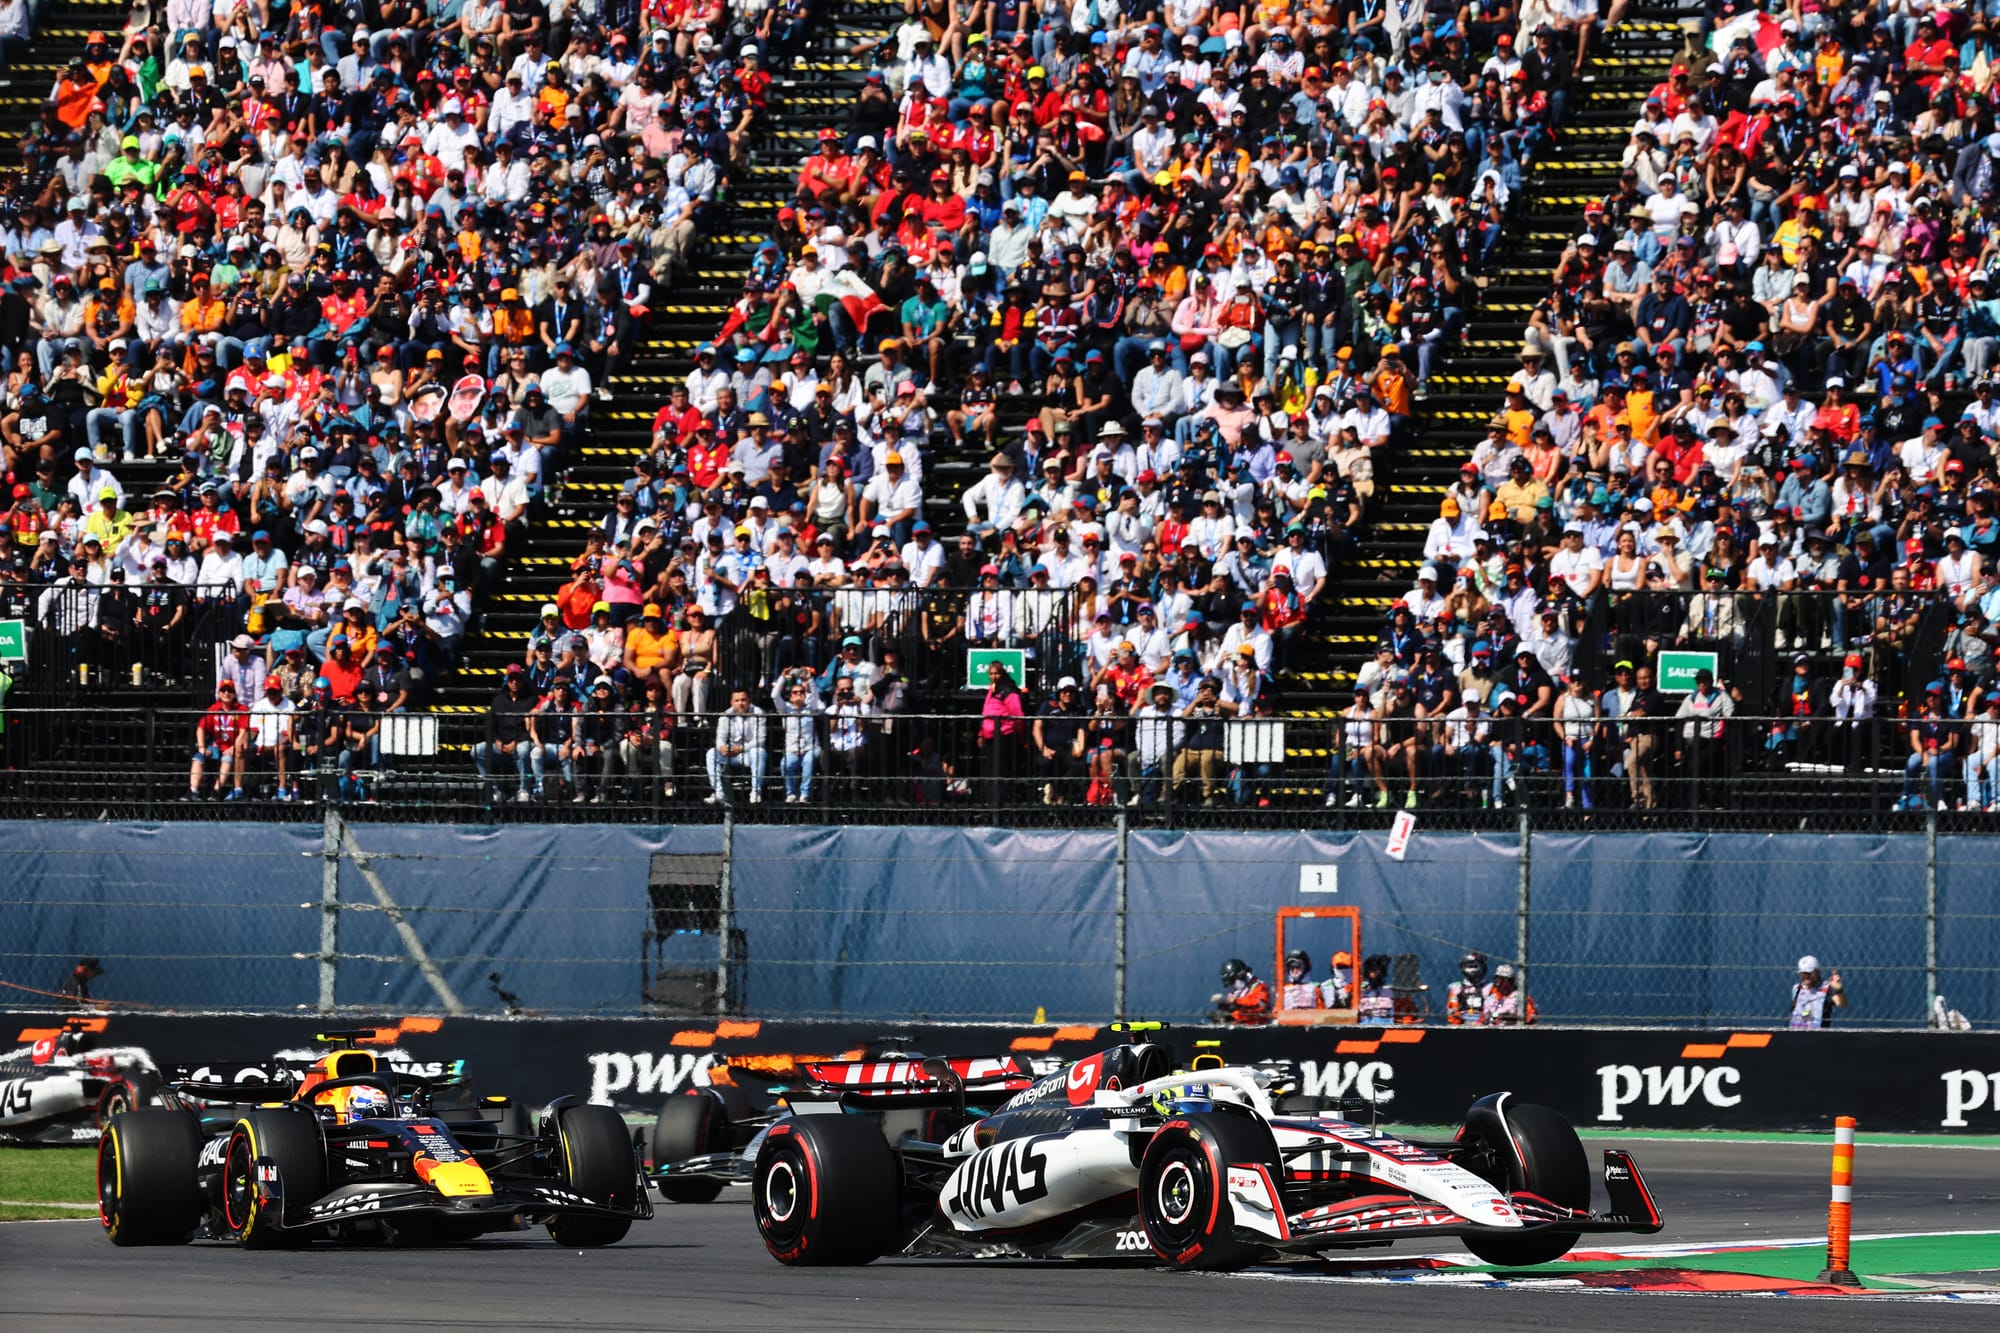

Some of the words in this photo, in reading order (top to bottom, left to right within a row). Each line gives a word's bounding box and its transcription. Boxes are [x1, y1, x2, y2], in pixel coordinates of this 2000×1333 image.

[1667, 667, 1699, 678] SALID
[1006, 1075, 1066, 1111] MoneyGram
[1596, 1064, 1742, 1121] pwc
[1116, 1231, 1152, 1250] ZOO
